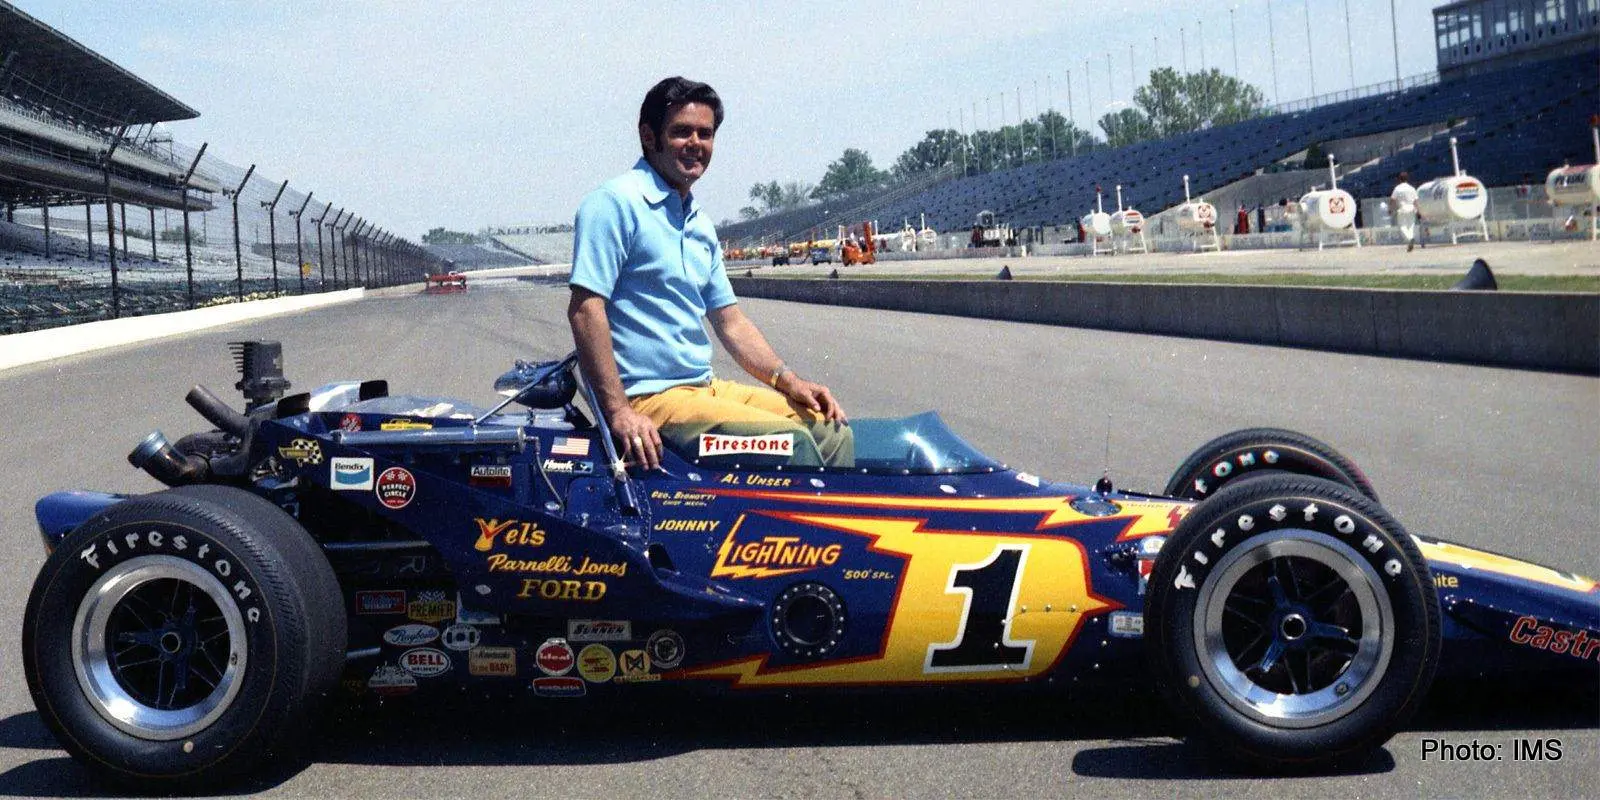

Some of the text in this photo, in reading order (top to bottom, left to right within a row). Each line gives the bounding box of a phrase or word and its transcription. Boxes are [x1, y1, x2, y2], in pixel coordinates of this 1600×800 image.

[703, 437, 789, 452] Firestone
[334, 462, 364, 471] Bendix
[472, 466, 511, 476] Autolite
[543, 459, 574, 470] Hawk
[382, 484, 411, 492] PERFECT
[384, 490, 407, 498] CIRCLE
[654, 520, 720, 531] JOHNNY
[1174, 503, 1402, 591] Firestone
[488, 554, 627, 577] Parnelli Jones
[81, 530, 261, 625] Firestone
[517, 578, 606, 601] FORD
[410, 602, 454, 617] PREMIER
[925, 544, 1034, 673] 1
[1510, 616, 1600, 661] Castr
[408, 654, 444, 666] BELL
